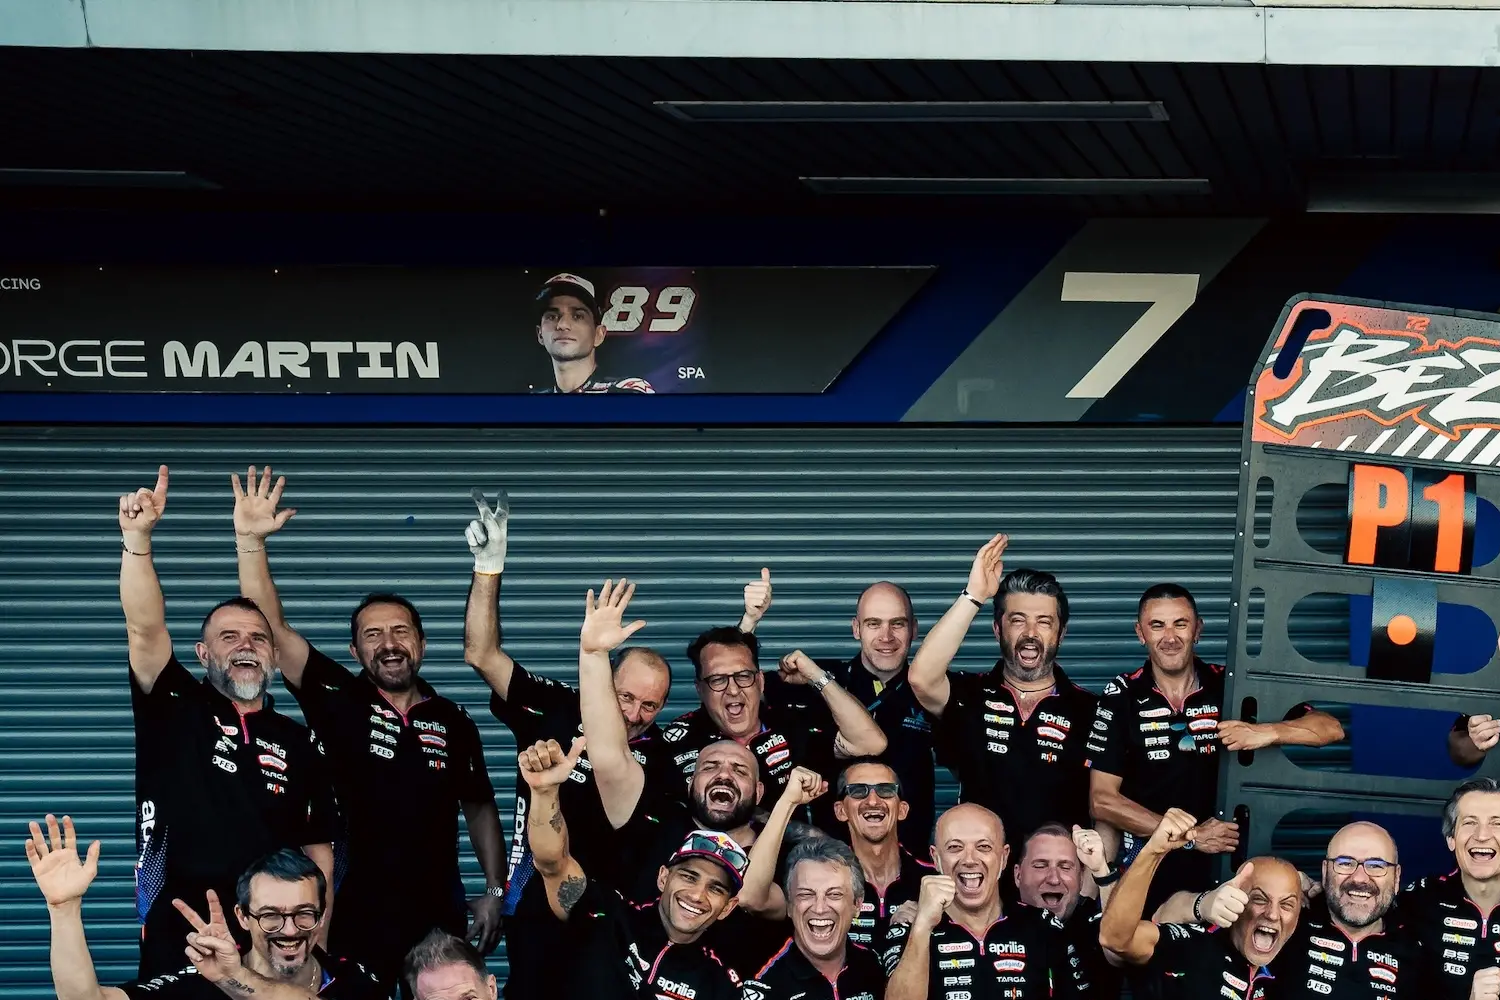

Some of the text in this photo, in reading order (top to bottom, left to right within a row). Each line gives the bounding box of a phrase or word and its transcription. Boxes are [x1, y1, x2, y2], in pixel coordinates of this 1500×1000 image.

[0, 277, 41, 290] CING
[600, 286, 698, 333] 89
[1406, 315, 1431, 332] 72
[1060, 271, 1201, 399] 7
[162, 341, 441, 379] MARTIN
[677, 366, 706, 379] SPA
[1348, 463, 1466, 573] P1
[1185, 704, 1219, 718] aprilia
[412, 718, 447, 734] aprilia
[1038, 711, 1071, 729] aprilia
[255, 737, 287, 759] aprilia
[756, 733, 787, 755] aprilia
[1037, 739, 1064, 750] TARGA
[421, 746, 449, 757] TARGA
[261, 768, 289, 782] TARGA
[506, 795, 526, 882] aprilia
[1451, 919, 1476, 928] Castrol
[944, 943, 971, 952] Castrol
[988, 941, 1026, 956] aprilia
[1317, 938, 1344, 951] Castrol
[1366, 950, 1399, 969] aprilia
[1443, 948, 1470, 960] BS
[1309, 963, 1337, 977] BS
[1449, 965, 1464, 974] FES
[943, 975, 973, 984] BS
[656, 976, 697, 1000] aprilia
[1314, 982, 1330, 993] FES
[1369, 981, 1397, 993] TARGA
